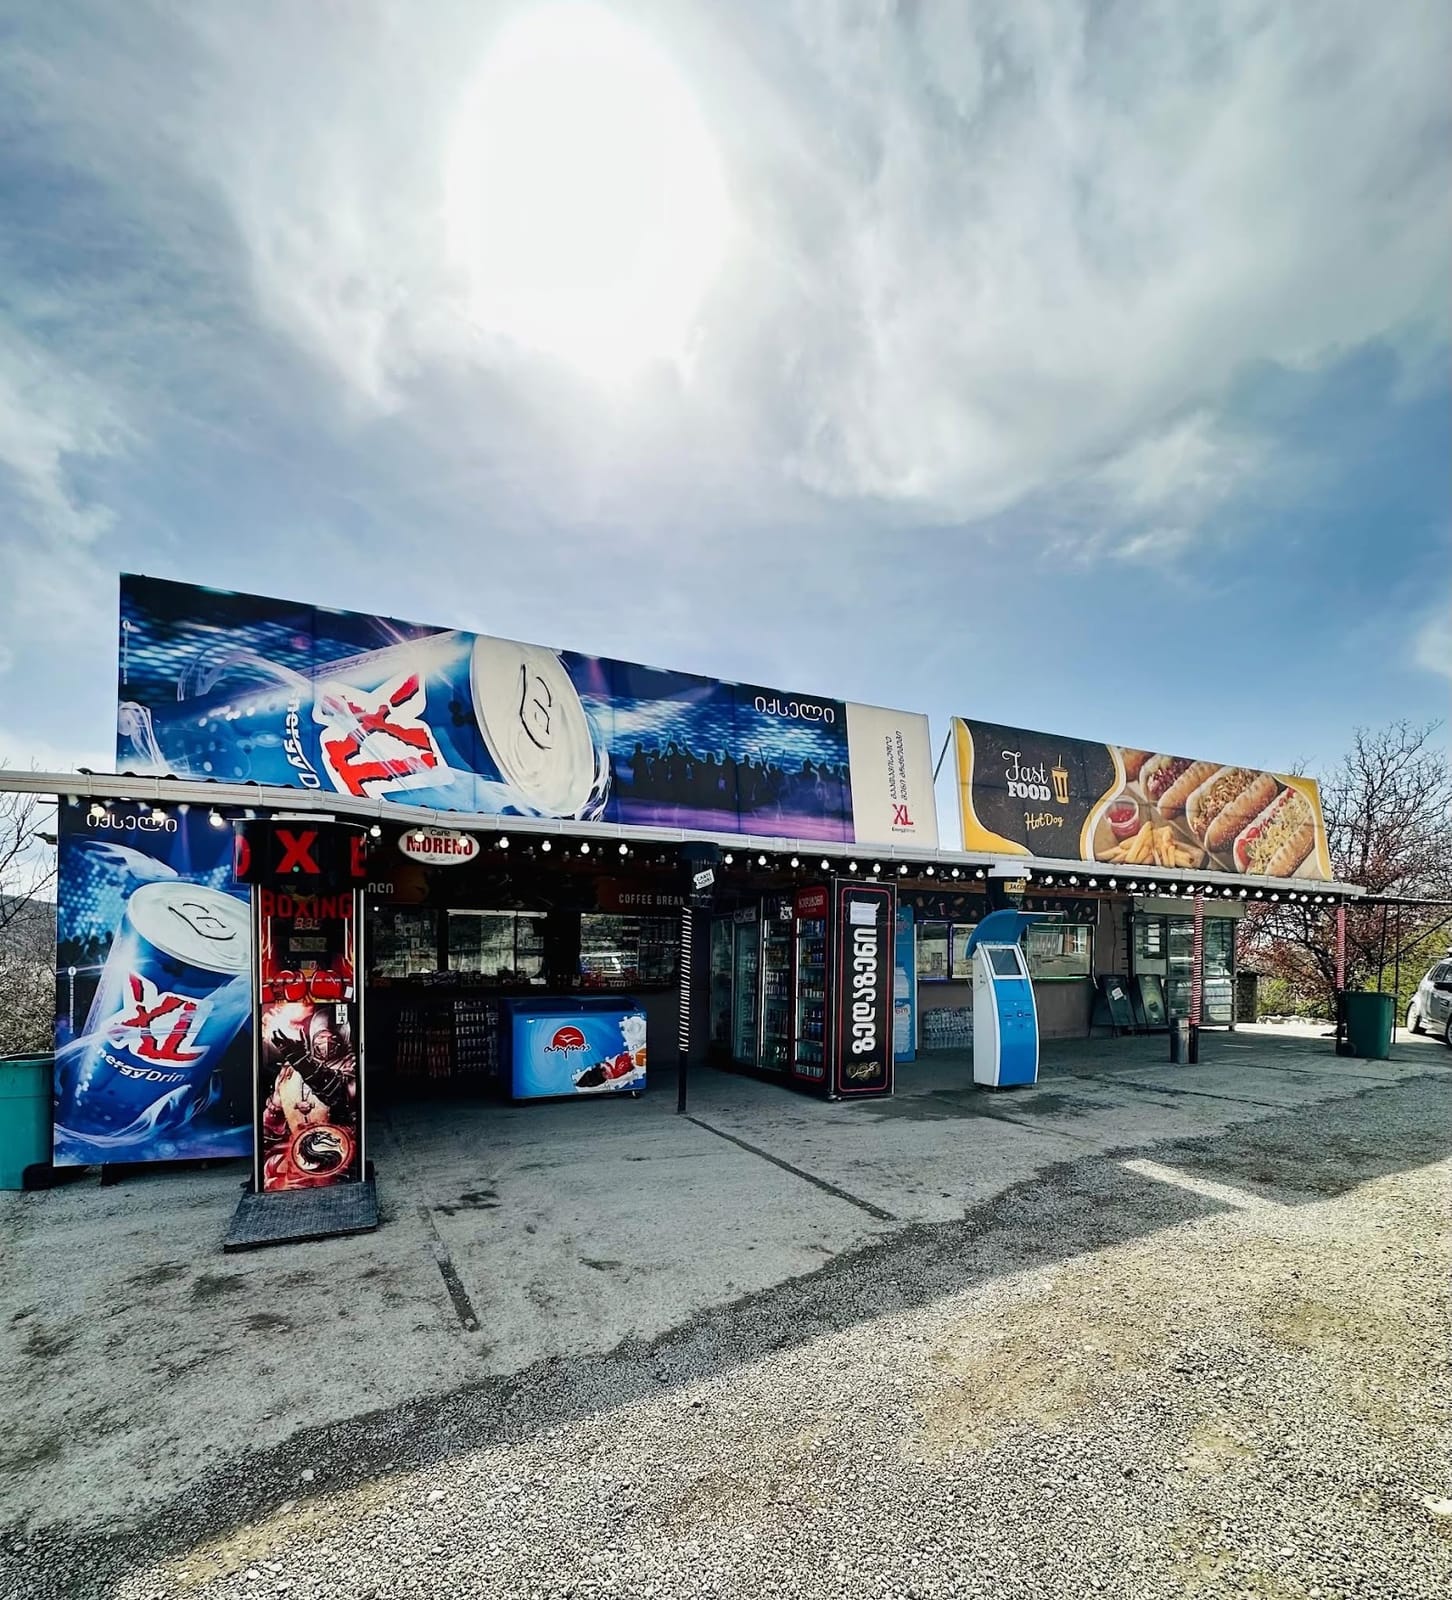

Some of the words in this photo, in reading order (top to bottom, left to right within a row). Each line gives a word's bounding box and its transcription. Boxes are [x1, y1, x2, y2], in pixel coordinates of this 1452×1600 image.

[754, 696, 835, 724] იქსელი
[1001, 750, 1049, 785] Fast
[1007, 781, 1052, 801] FOOD
[892, 804, 914, 825] XL
[406, 835, 473, 856] MORENO
[261, 888, 353, 919] BOXING
[619, 893, 652, 905] COFFEE
[851, 928, 879, 1055] ზედაზენი
[108, 973, 200, 1062] XL
